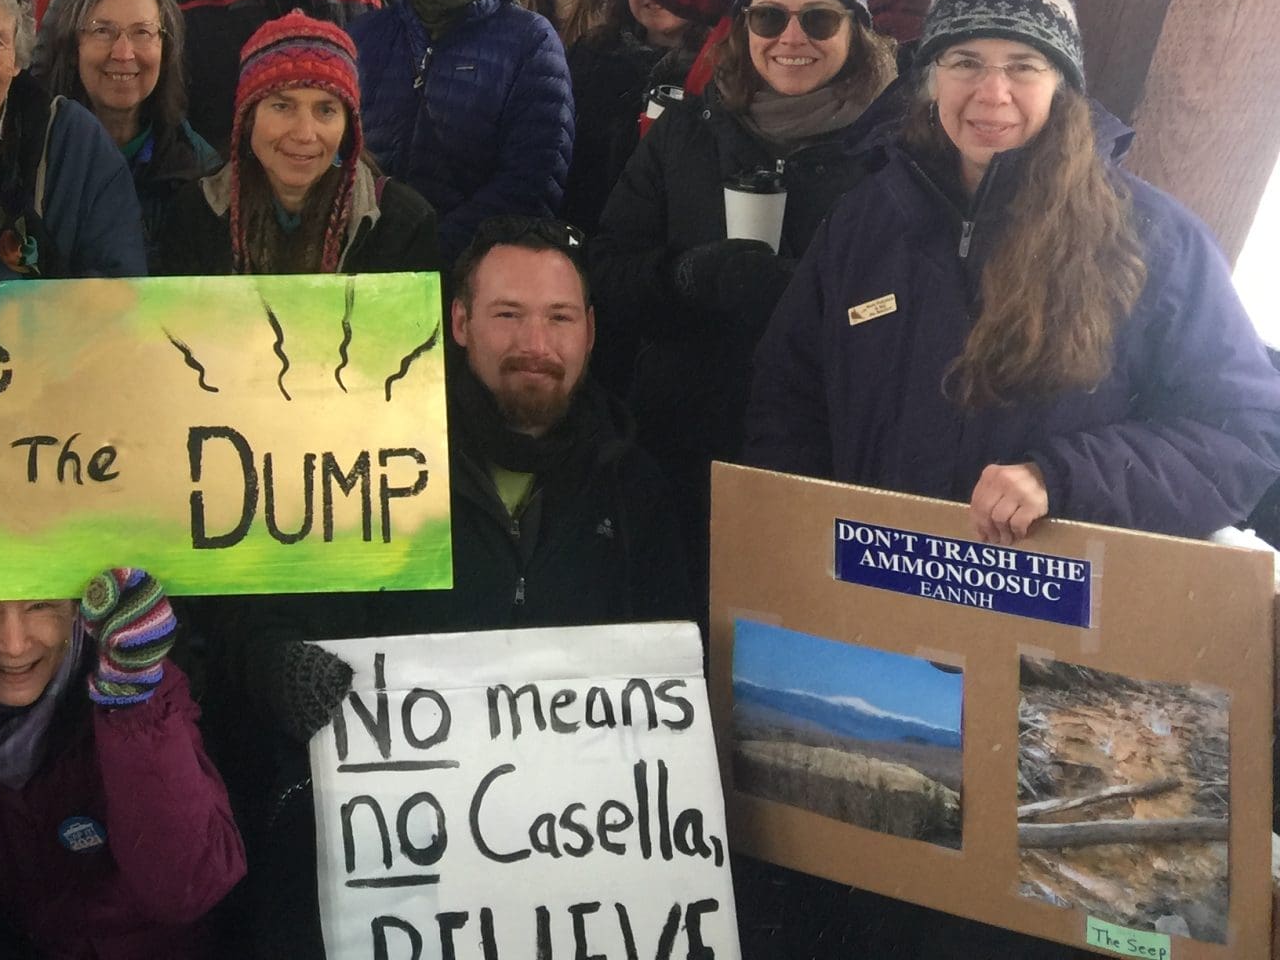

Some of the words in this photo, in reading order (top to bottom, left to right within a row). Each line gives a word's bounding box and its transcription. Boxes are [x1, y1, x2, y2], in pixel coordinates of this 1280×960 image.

[10, 431, 120, 486] The
[187, 425, 429, 550] DUMP
[838, 522, 919, 553] DON'T
[925, 538, 1018, 571] TRASH
[1026, 554, 1086, 583] THE
[859, 548, 1062, 602] AMMONOOSUC
[919, 581, 994, 609] EANNH
[332, 653, 452, 761] No
[486, 678, 696, 741] means
[341, 791, 448, 875] no
[468, 759, 724, 868] Casella,
[1091, 926, 1121, 949] The
